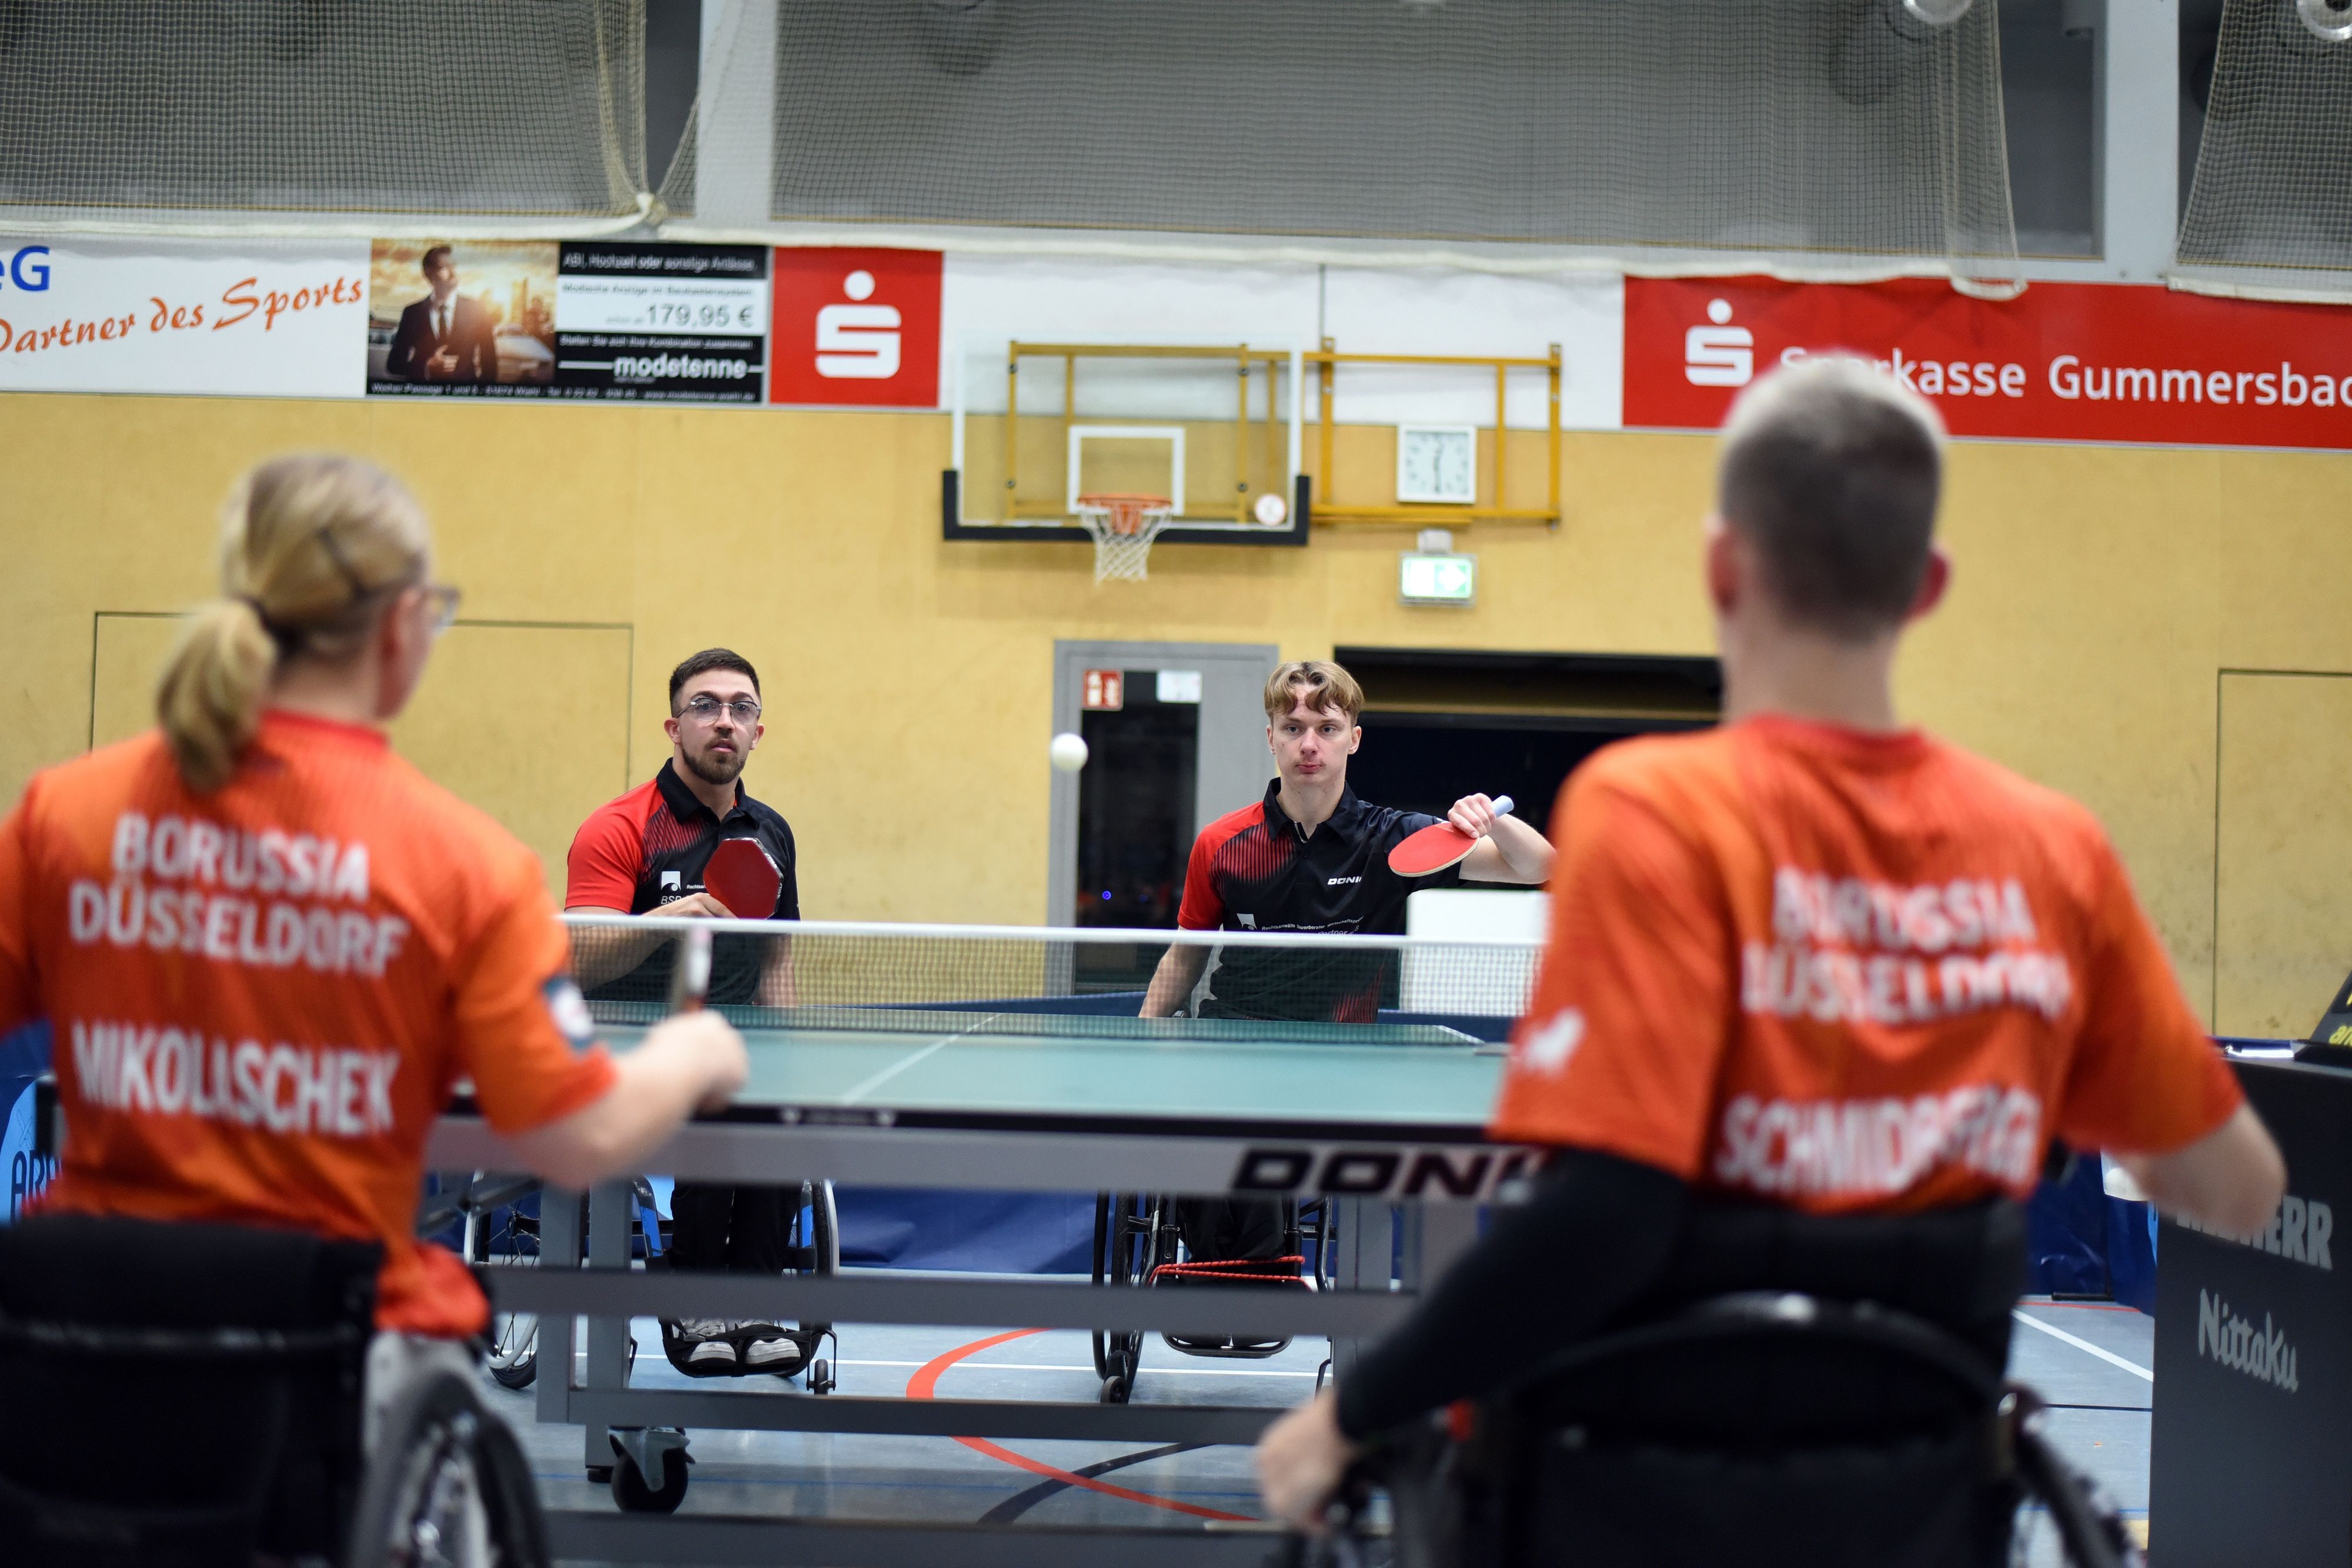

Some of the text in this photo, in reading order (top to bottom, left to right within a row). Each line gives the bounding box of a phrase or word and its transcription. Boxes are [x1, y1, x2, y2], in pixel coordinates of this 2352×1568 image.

[0, 245, 51, 292] G
[150, 296, 204, 333] des
[212, 276, 363, 332] Sports
[647, 303, 755, 329] 179,95 €
[613, 353, 748, 380] modetenne
[113, 813, 369, 902] BORUSSIA
[1327, 876, 1362, 885] DONI
[69, 875, 411, 976] DÜSSELDORF
[2198, 1288, 2298, 1393] Nittaku
